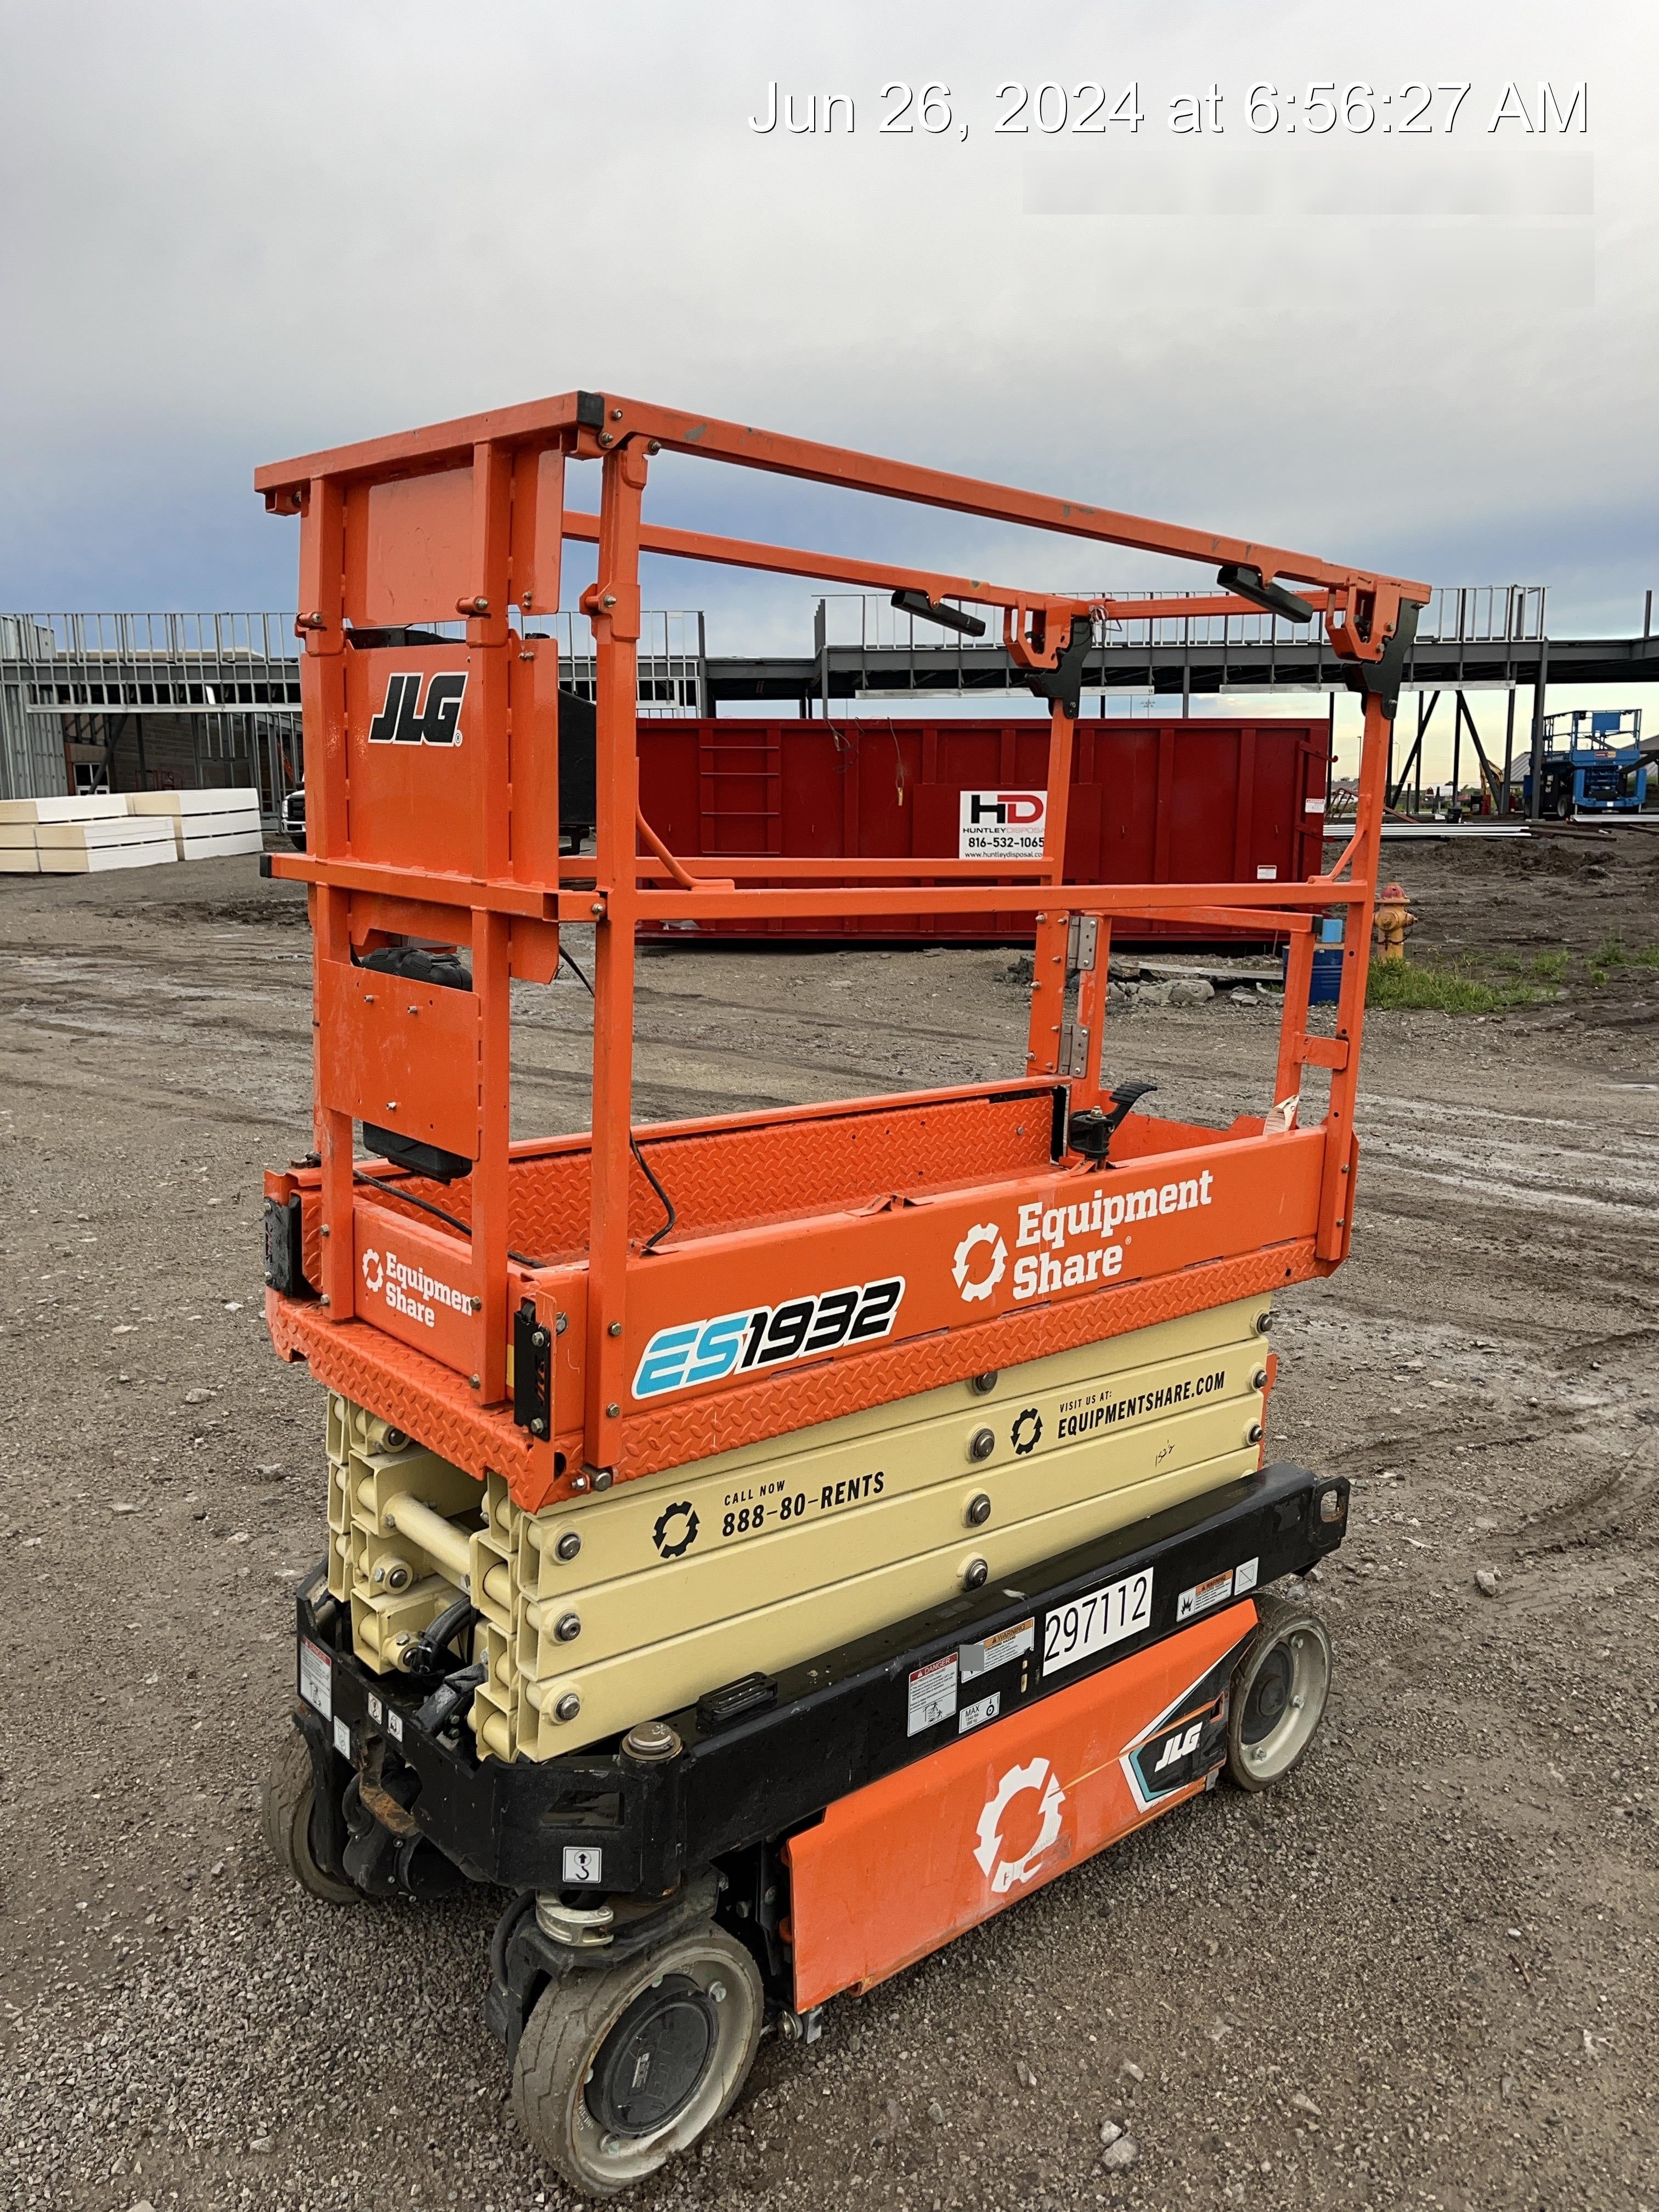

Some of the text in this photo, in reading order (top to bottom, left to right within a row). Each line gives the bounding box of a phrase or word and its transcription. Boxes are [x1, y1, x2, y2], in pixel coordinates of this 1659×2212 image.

[368, 672, 468, 747] JLG
[971, 794, 1043, 823] HD
[964, 851, 1043, 859] www.huntleydisposal.co
[968, 837, 1045, 848] 816-532-1065
[1015, 1169, 1214, 1249] Equipment
[386, 1251, 472, 1316] Equipmen
[1012, 1245, 1123, 1300] Share
[386, 1281, 435, 1328] Share
[634, 1277, 904, 1398] ES1932
[1058, 1371, 1226, 1439] EQUIPMENTSHARE.COM
[1059, 1390, 1112, 1413] VISIT US AT:
[722, 1471, 884, 1537] 888-80-RENTS
[724, 1480, 786, 1506] CALL NOW
[998, 1624, 1025, 1640] WARNING
[1044, 1576, 1147, 1662] 297112
[924, 1657, 950, 1674] DANGER
[966, 1704, 980, 1717] MAX
[1154, 1721, 1203, 1773] JLG
